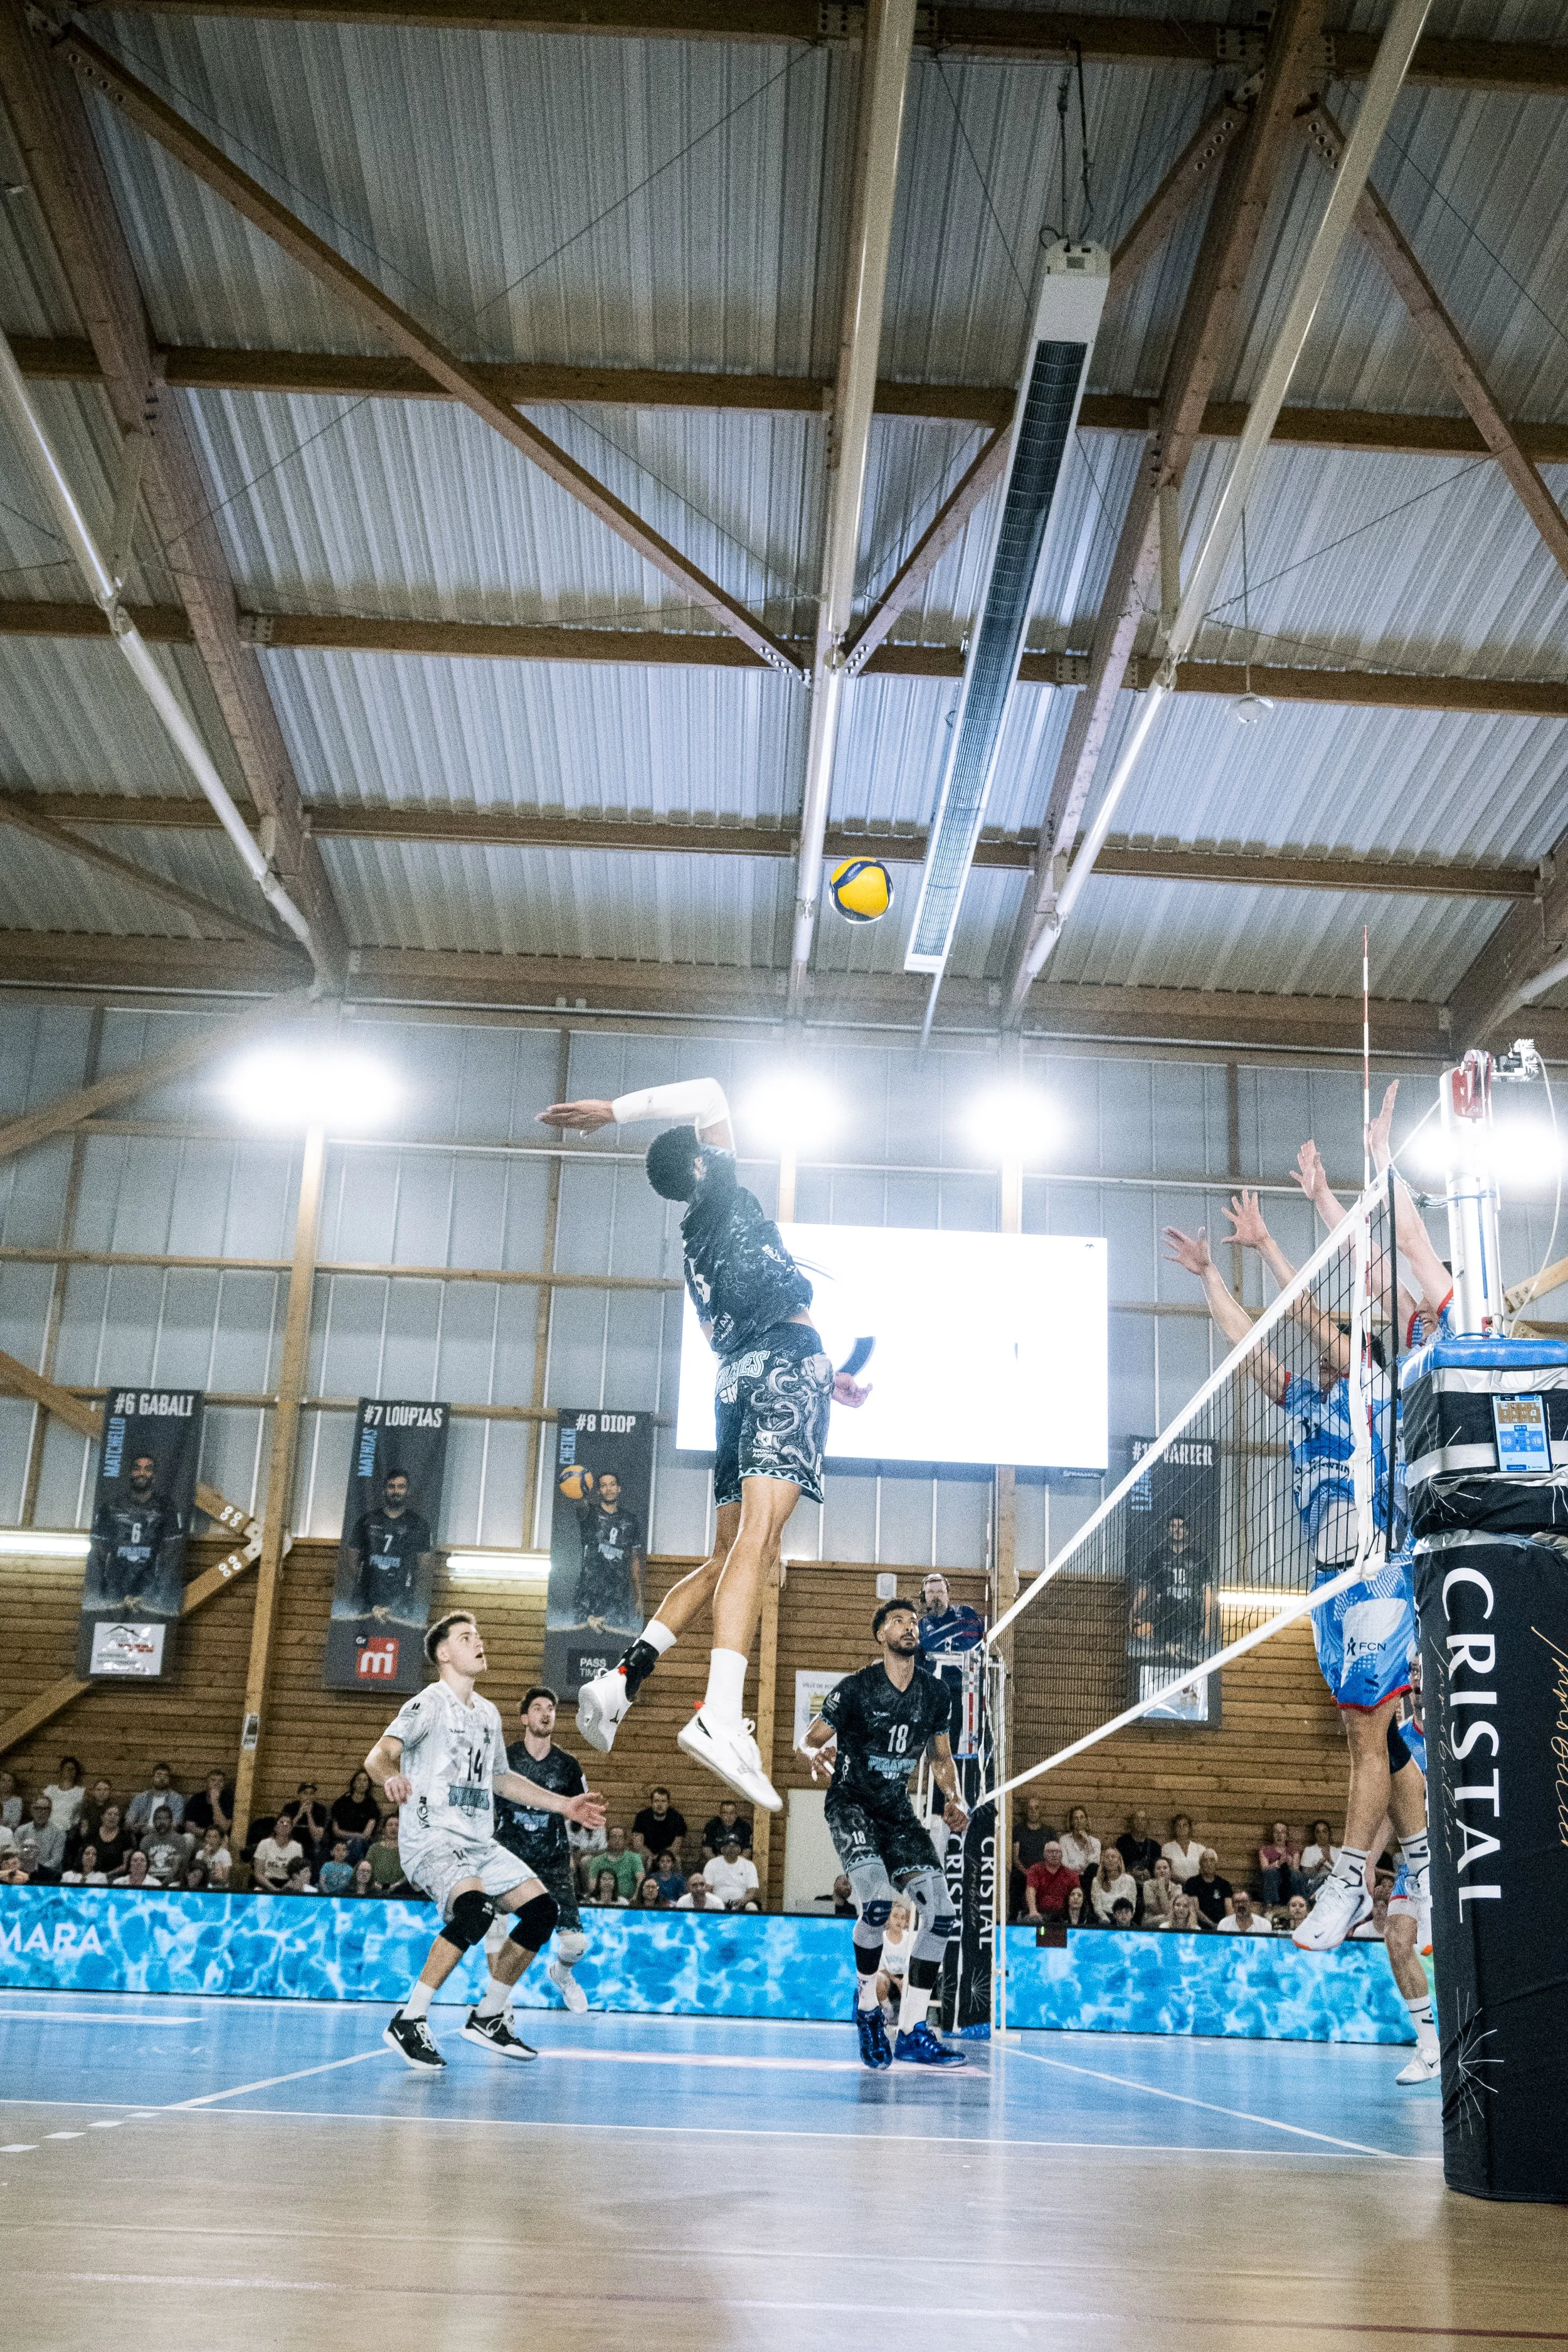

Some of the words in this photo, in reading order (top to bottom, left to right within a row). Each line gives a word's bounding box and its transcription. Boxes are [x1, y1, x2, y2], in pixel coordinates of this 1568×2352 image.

[114, 1392, 136, 1414] #6
[139, 1394, 194, 1416] GABALI
[364, 1405, 383, 1426] #7
[385, 1406, 443, 1428] LOUPIAS
[576, 1414, 596, 1432] #8
[600, 1414, 636, 1433] DIOP
[357, 1428, 378, 1477] MATHIAS
[383, 1534, 393, 1553] 7
[1359, 1642, 1386, 1651] FCN
[360, 1643, 394, 1674] mi
[580, 1658, 607, 1668] PASS
[887, 1725, 909, 1754] 18
[1442, 1567, 1502, 1924] CRISTAL
[467, 1747, 484, 1783] 14
[852, 1831, 867, 1845] 18
